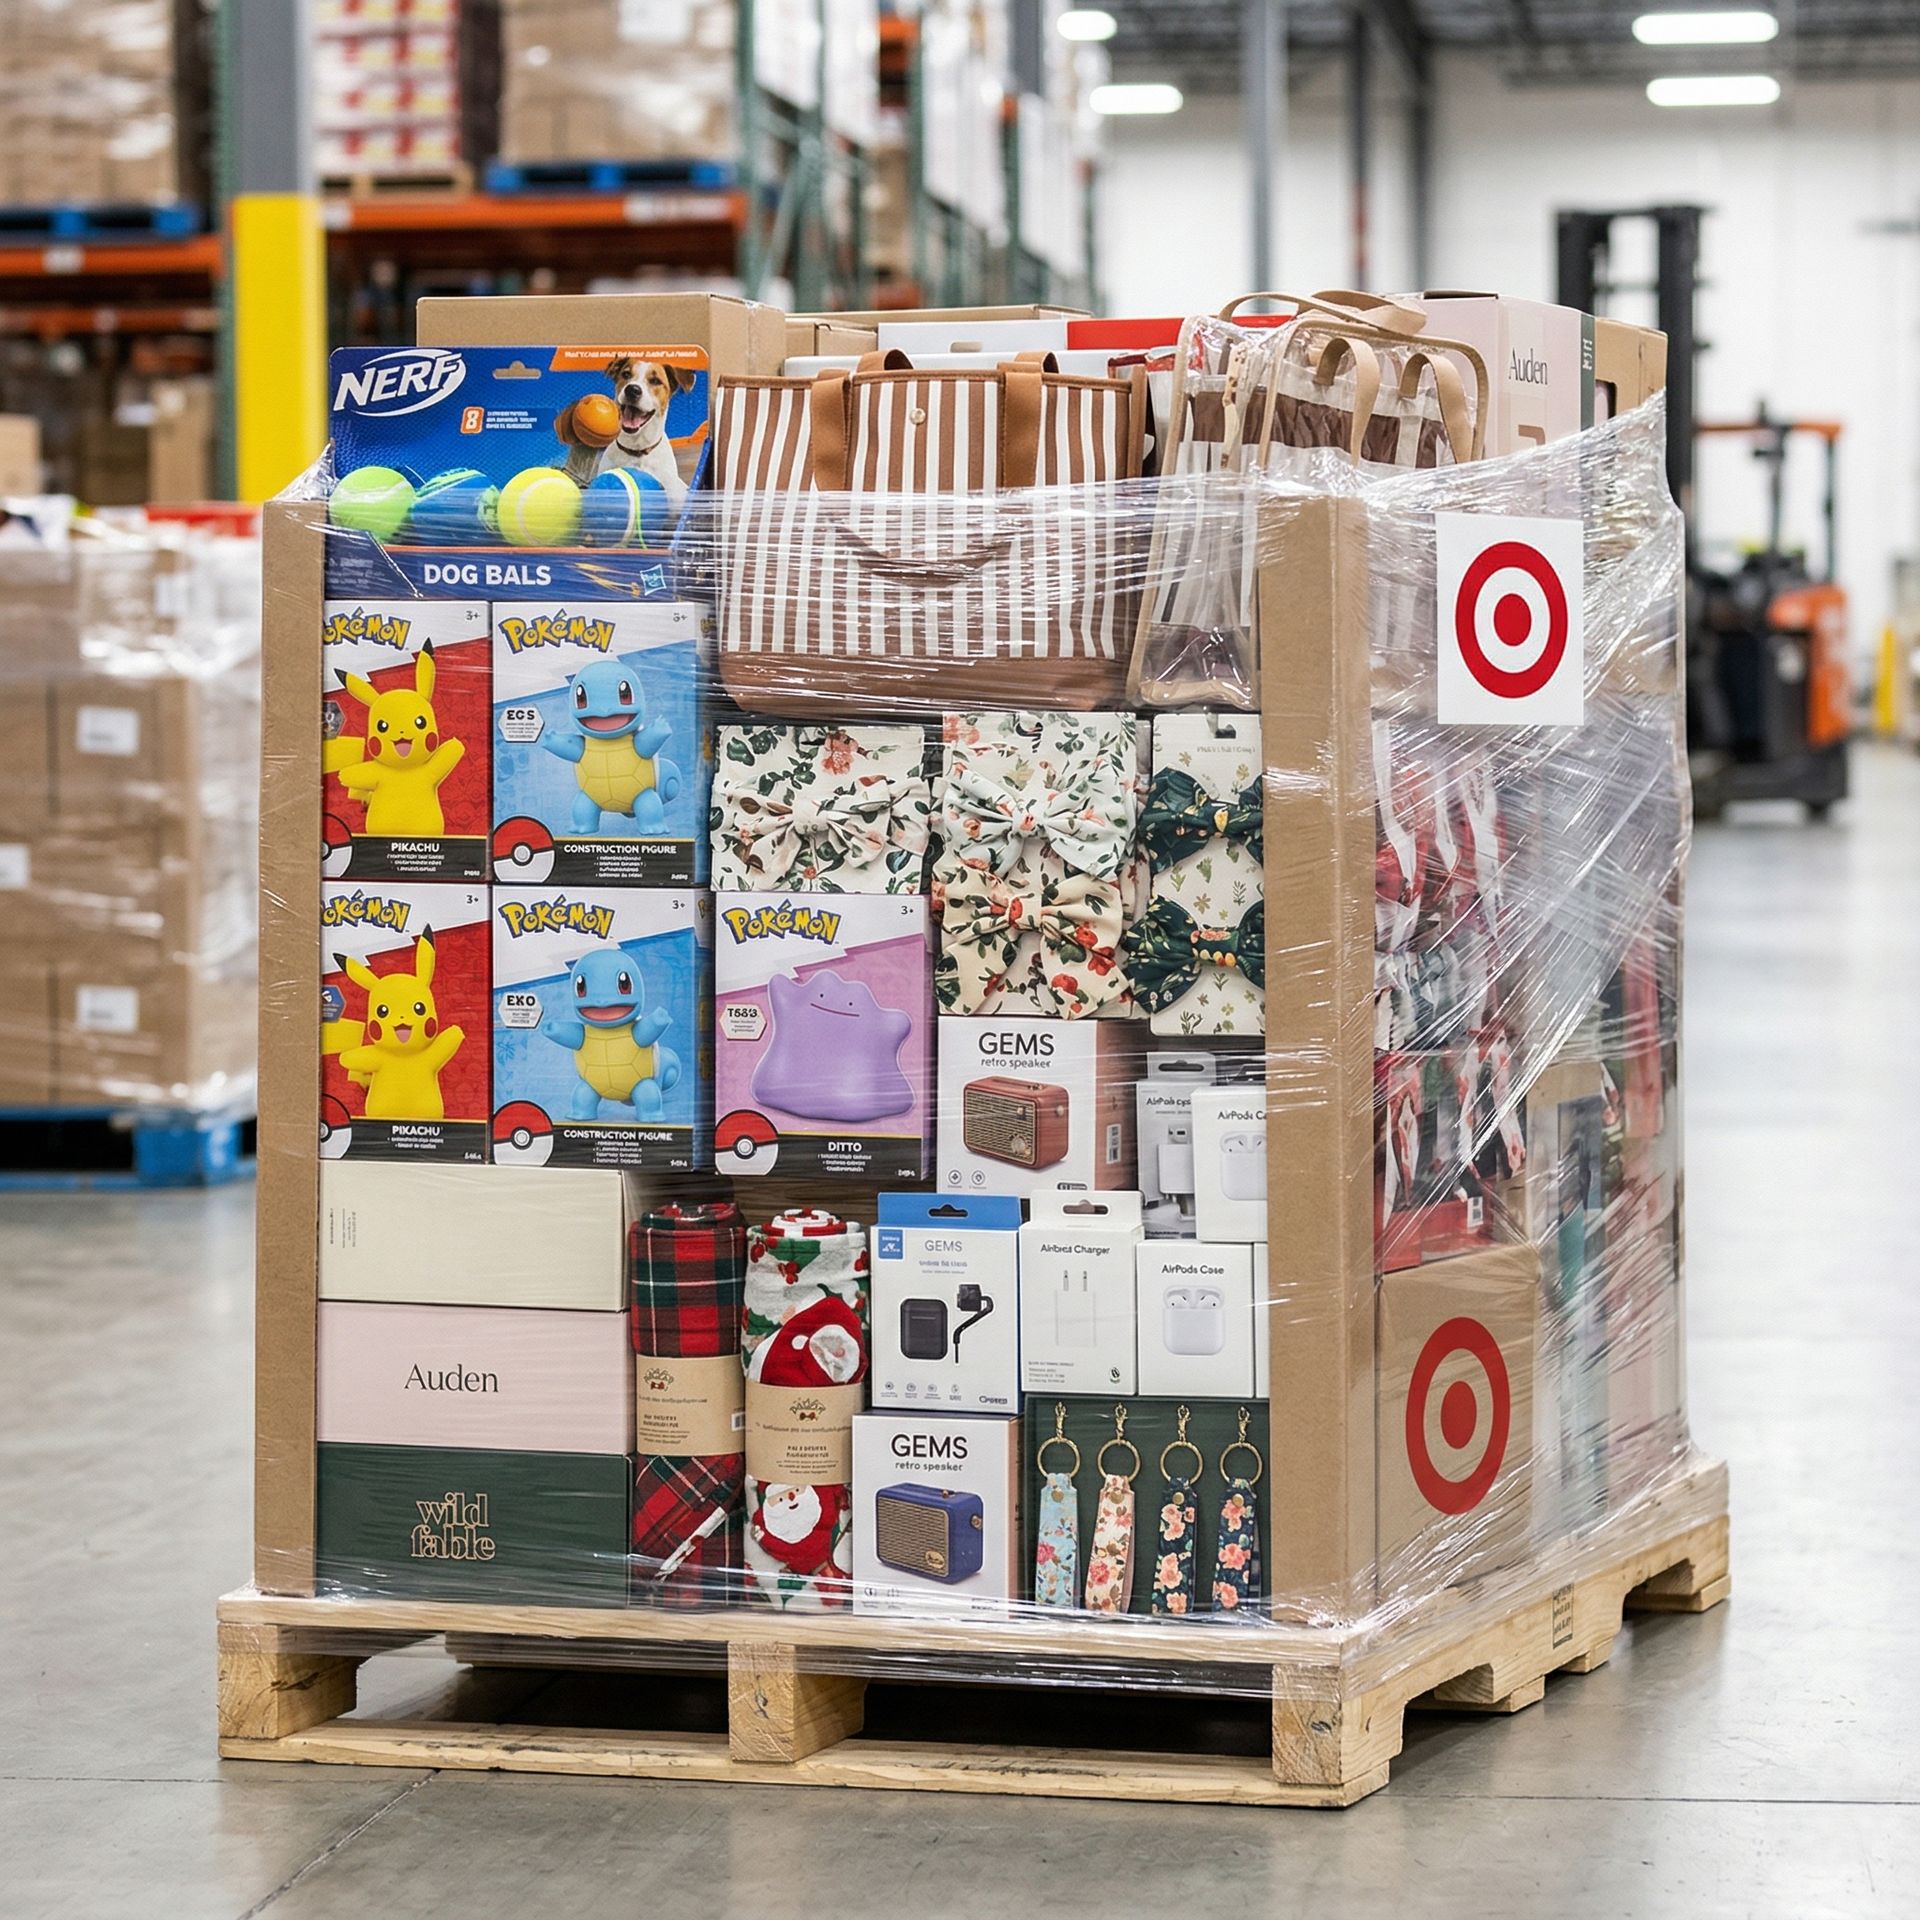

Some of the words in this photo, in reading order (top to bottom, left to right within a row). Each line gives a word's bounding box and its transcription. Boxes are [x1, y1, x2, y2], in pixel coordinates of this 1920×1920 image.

[1508, 347, 1548, 385] Auden
[332, 352, 463, 412] NERF
[423, 563, 479, 586] DOG
[485, 564, 552, 586] BALS
[563, 843, 640, 854] CONSTRUCTION
[641, 845, 677, 854] FIGURE
[978, 1032, 1055, 1056] GEMS
[981, 1058, 1005, 1067] retro
[563, 1129, 637, 1140] CONSTRUCTION
[828, 1141, 863, 1152] DITTO
[924, 1239, 963, 1252] GEMS
[404, 1363, 499, 1393] Auden
[891, 1434, 969, 1460] GEMS
[895, 1461, 920, 1471] retro
[415, 1491, 490, 1528] wild
[410, 1523, 496, 1561] fable
